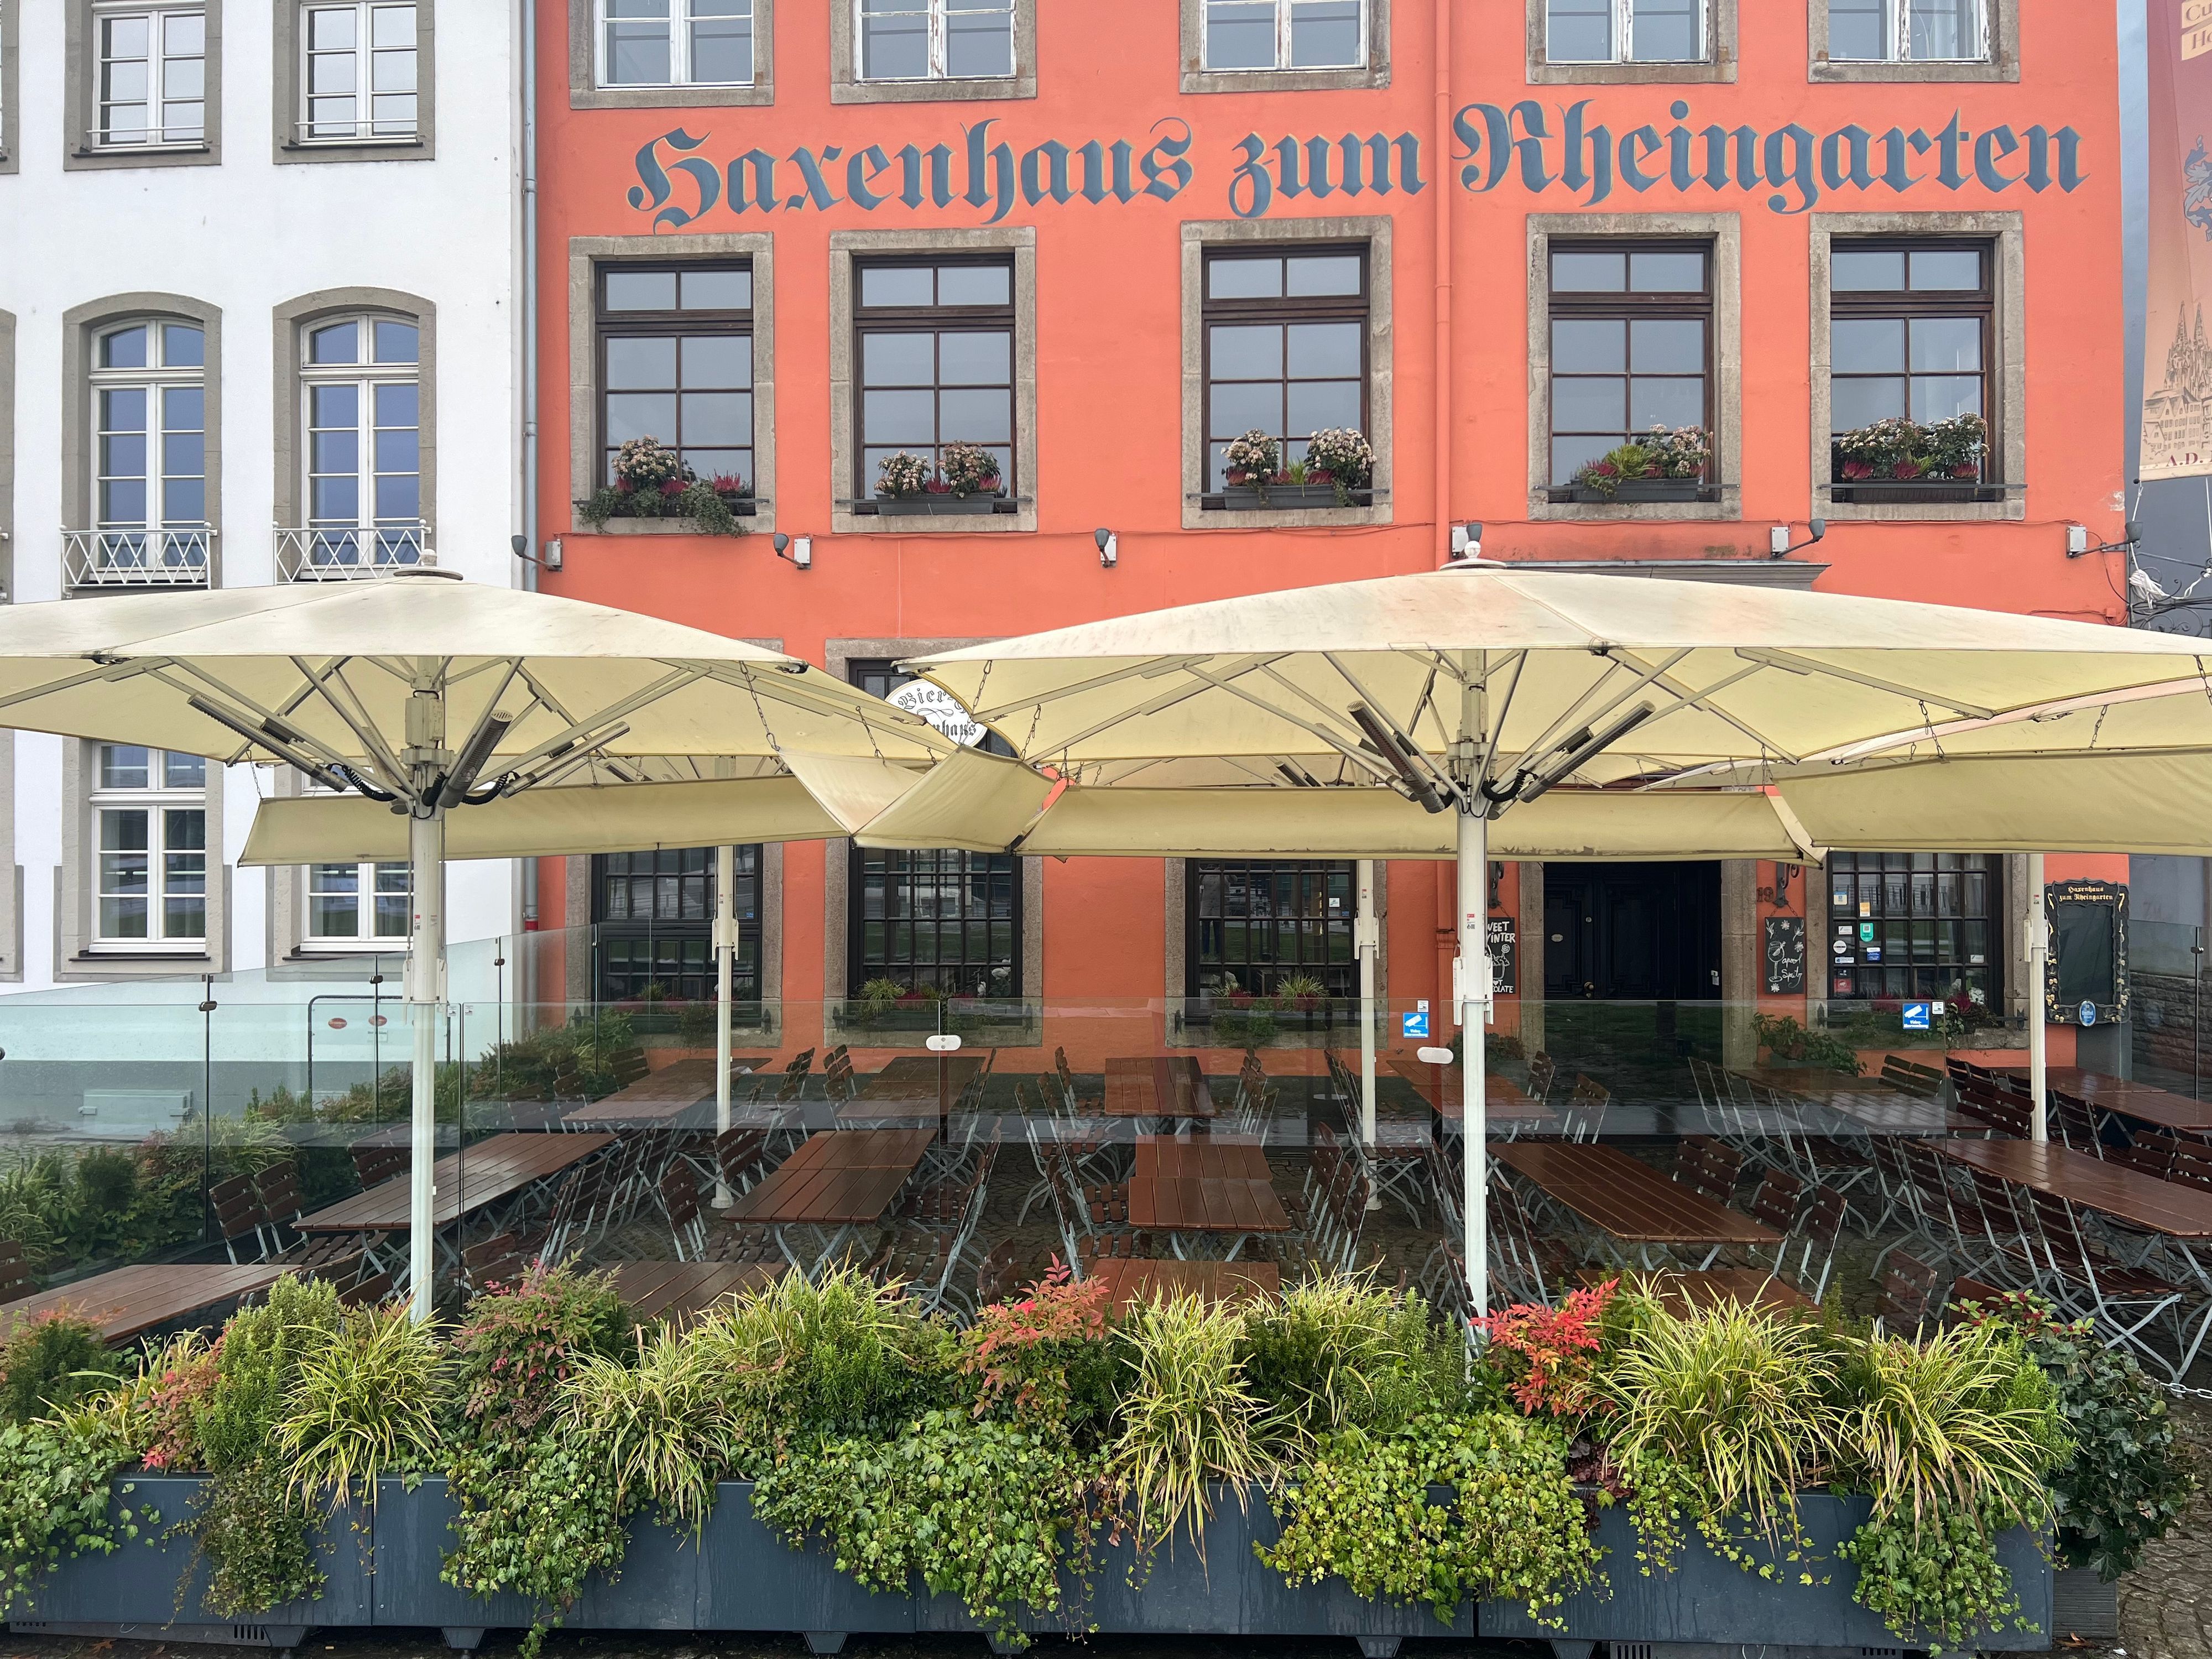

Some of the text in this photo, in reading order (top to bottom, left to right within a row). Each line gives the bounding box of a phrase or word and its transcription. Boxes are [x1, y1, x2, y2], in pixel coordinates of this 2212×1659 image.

[2186, 3, 2212, 21] Cu
[627, 99, 2090, 234] Haxenhaus zum Rheingarten
[1756, 886, 1773, 902] 19
